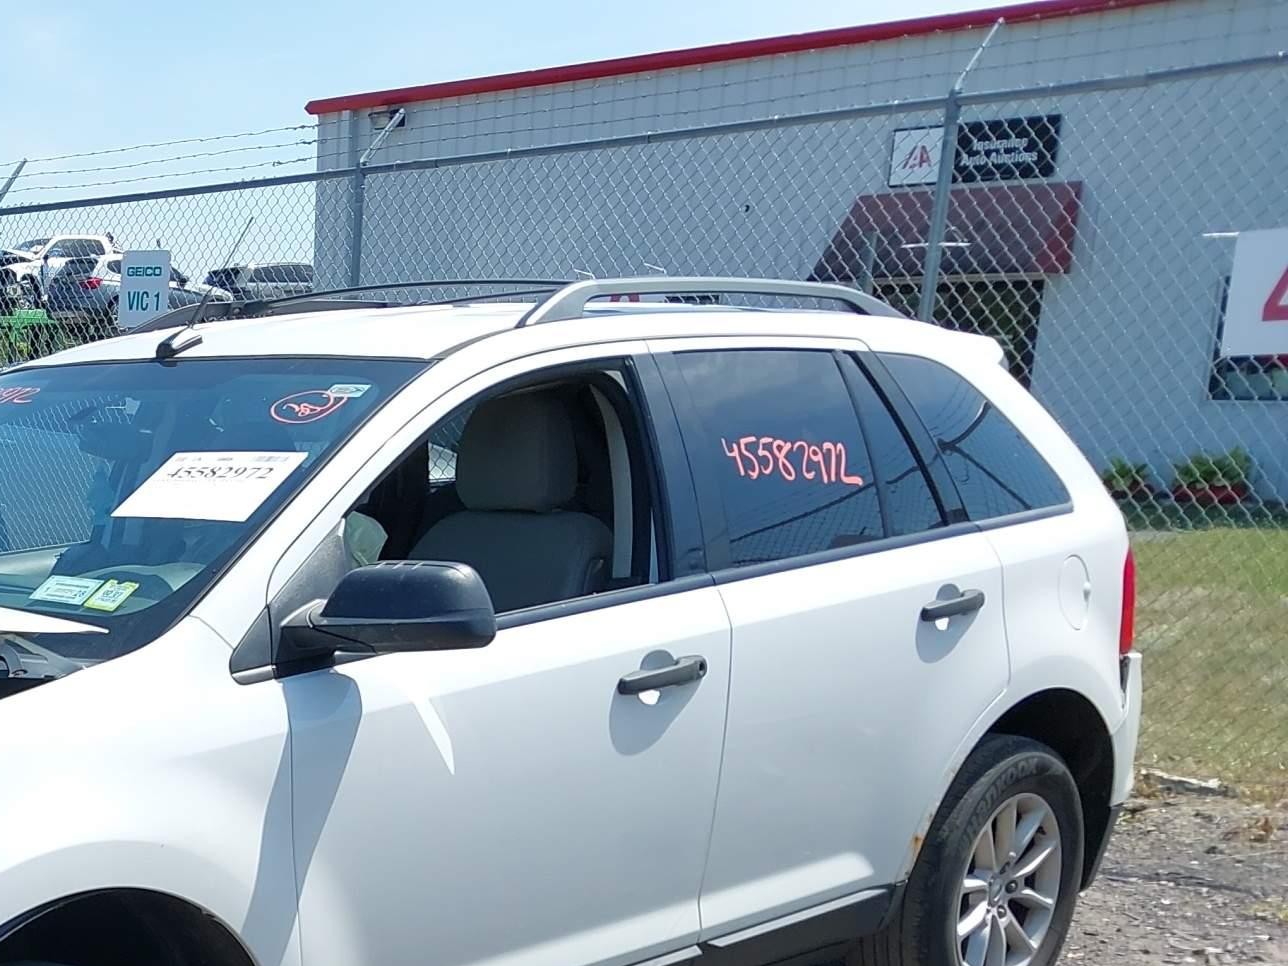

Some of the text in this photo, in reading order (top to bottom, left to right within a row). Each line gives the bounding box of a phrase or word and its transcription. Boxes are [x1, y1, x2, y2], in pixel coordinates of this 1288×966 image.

[960, 151, 1038, 166] Auto Auctions
[127, 266, 162, 277] GEICO
[127, 290, 160, 311] VIC 1
[721, 436, 864, 486] 45582972
[167, 466, 275, 479] 45582972
